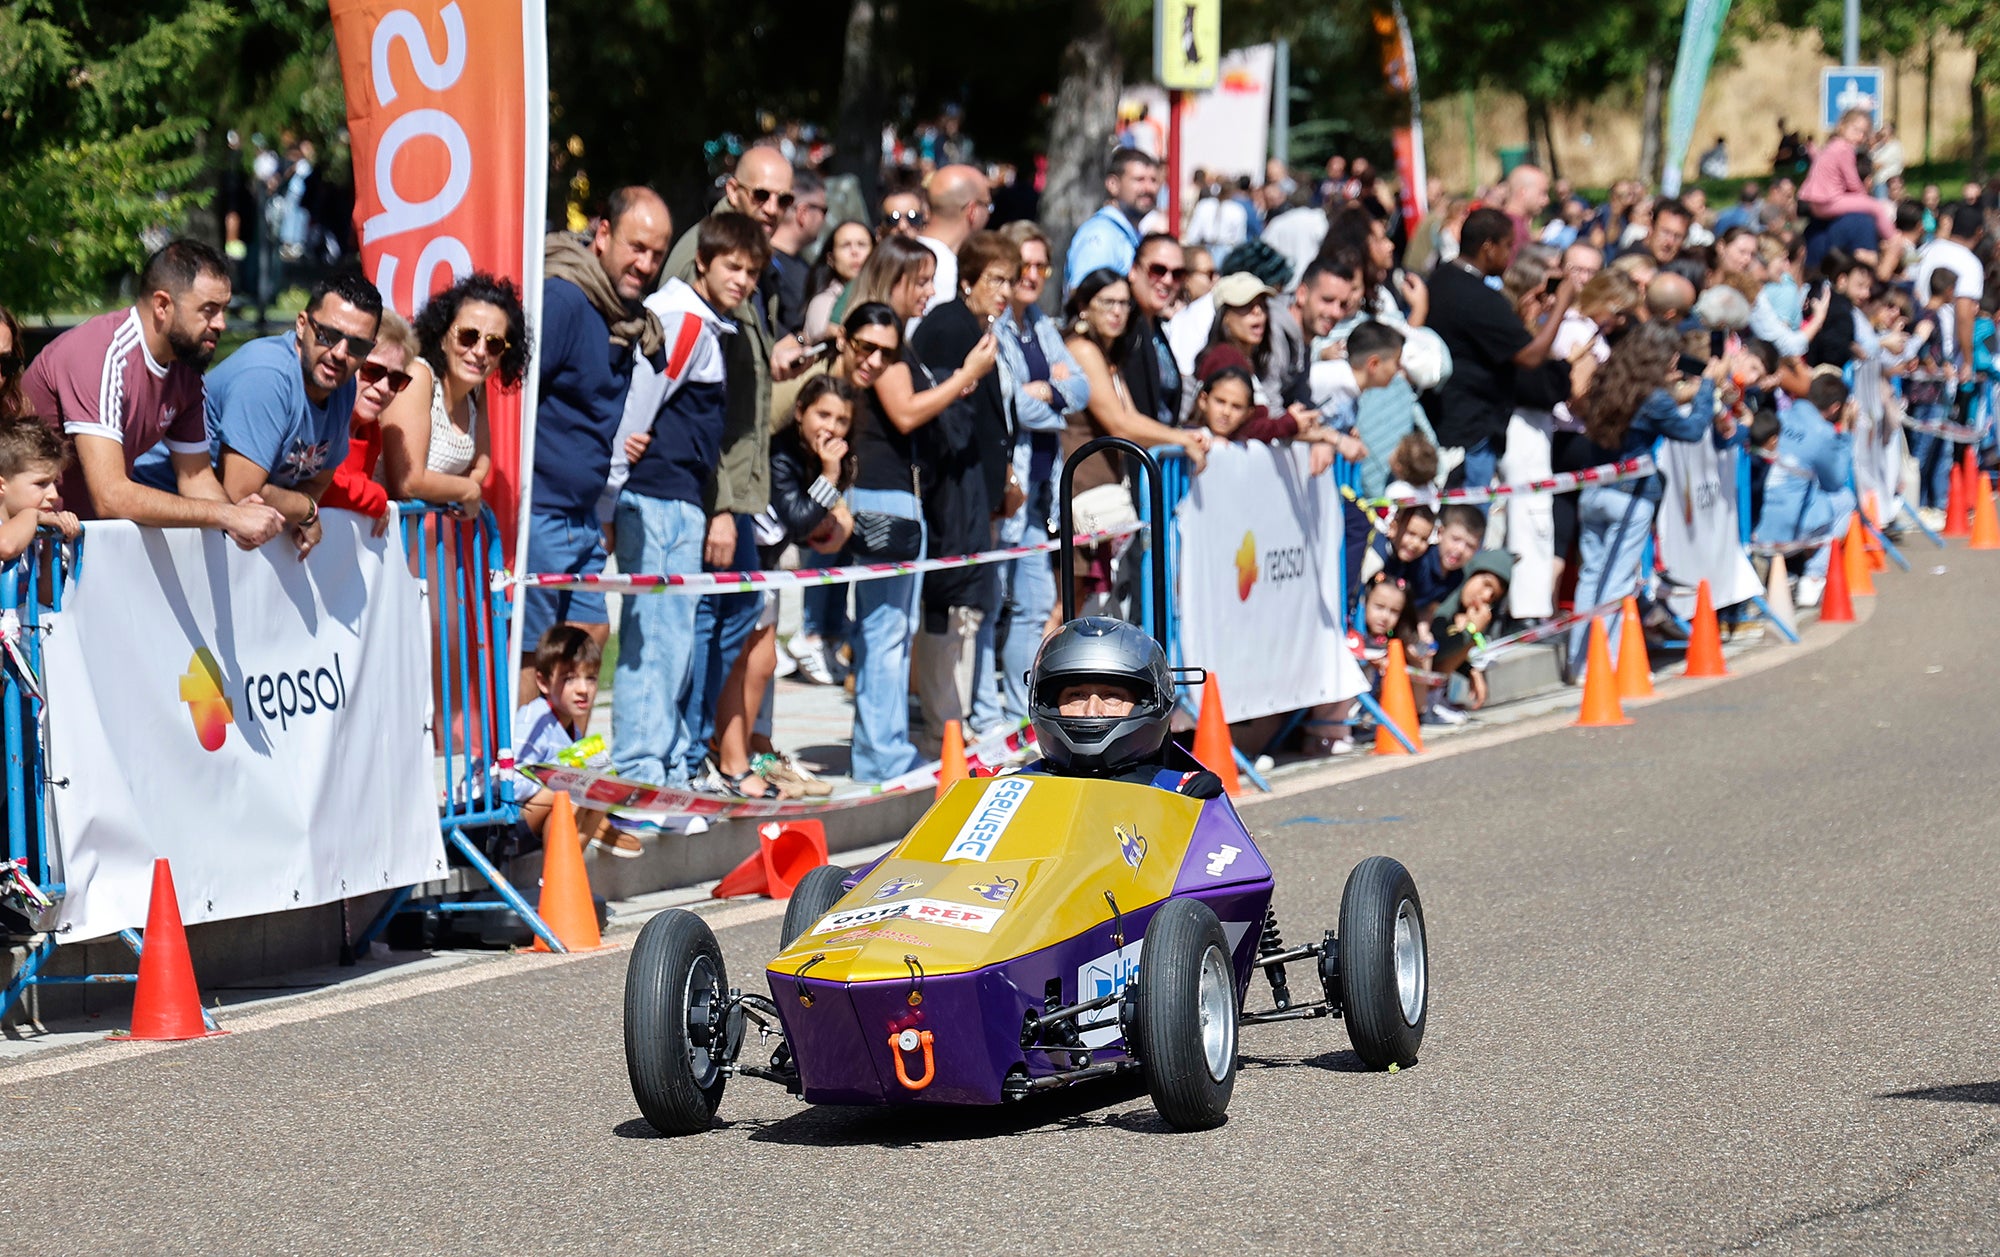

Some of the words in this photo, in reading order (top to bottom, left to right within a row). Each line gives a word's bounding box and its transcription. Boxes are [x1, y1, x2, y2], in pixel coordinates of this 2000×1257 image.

[244, 652, 346, 731] repsol
[833, 904, 911, 924] 0014
[918, 905, 984, 921] REP
